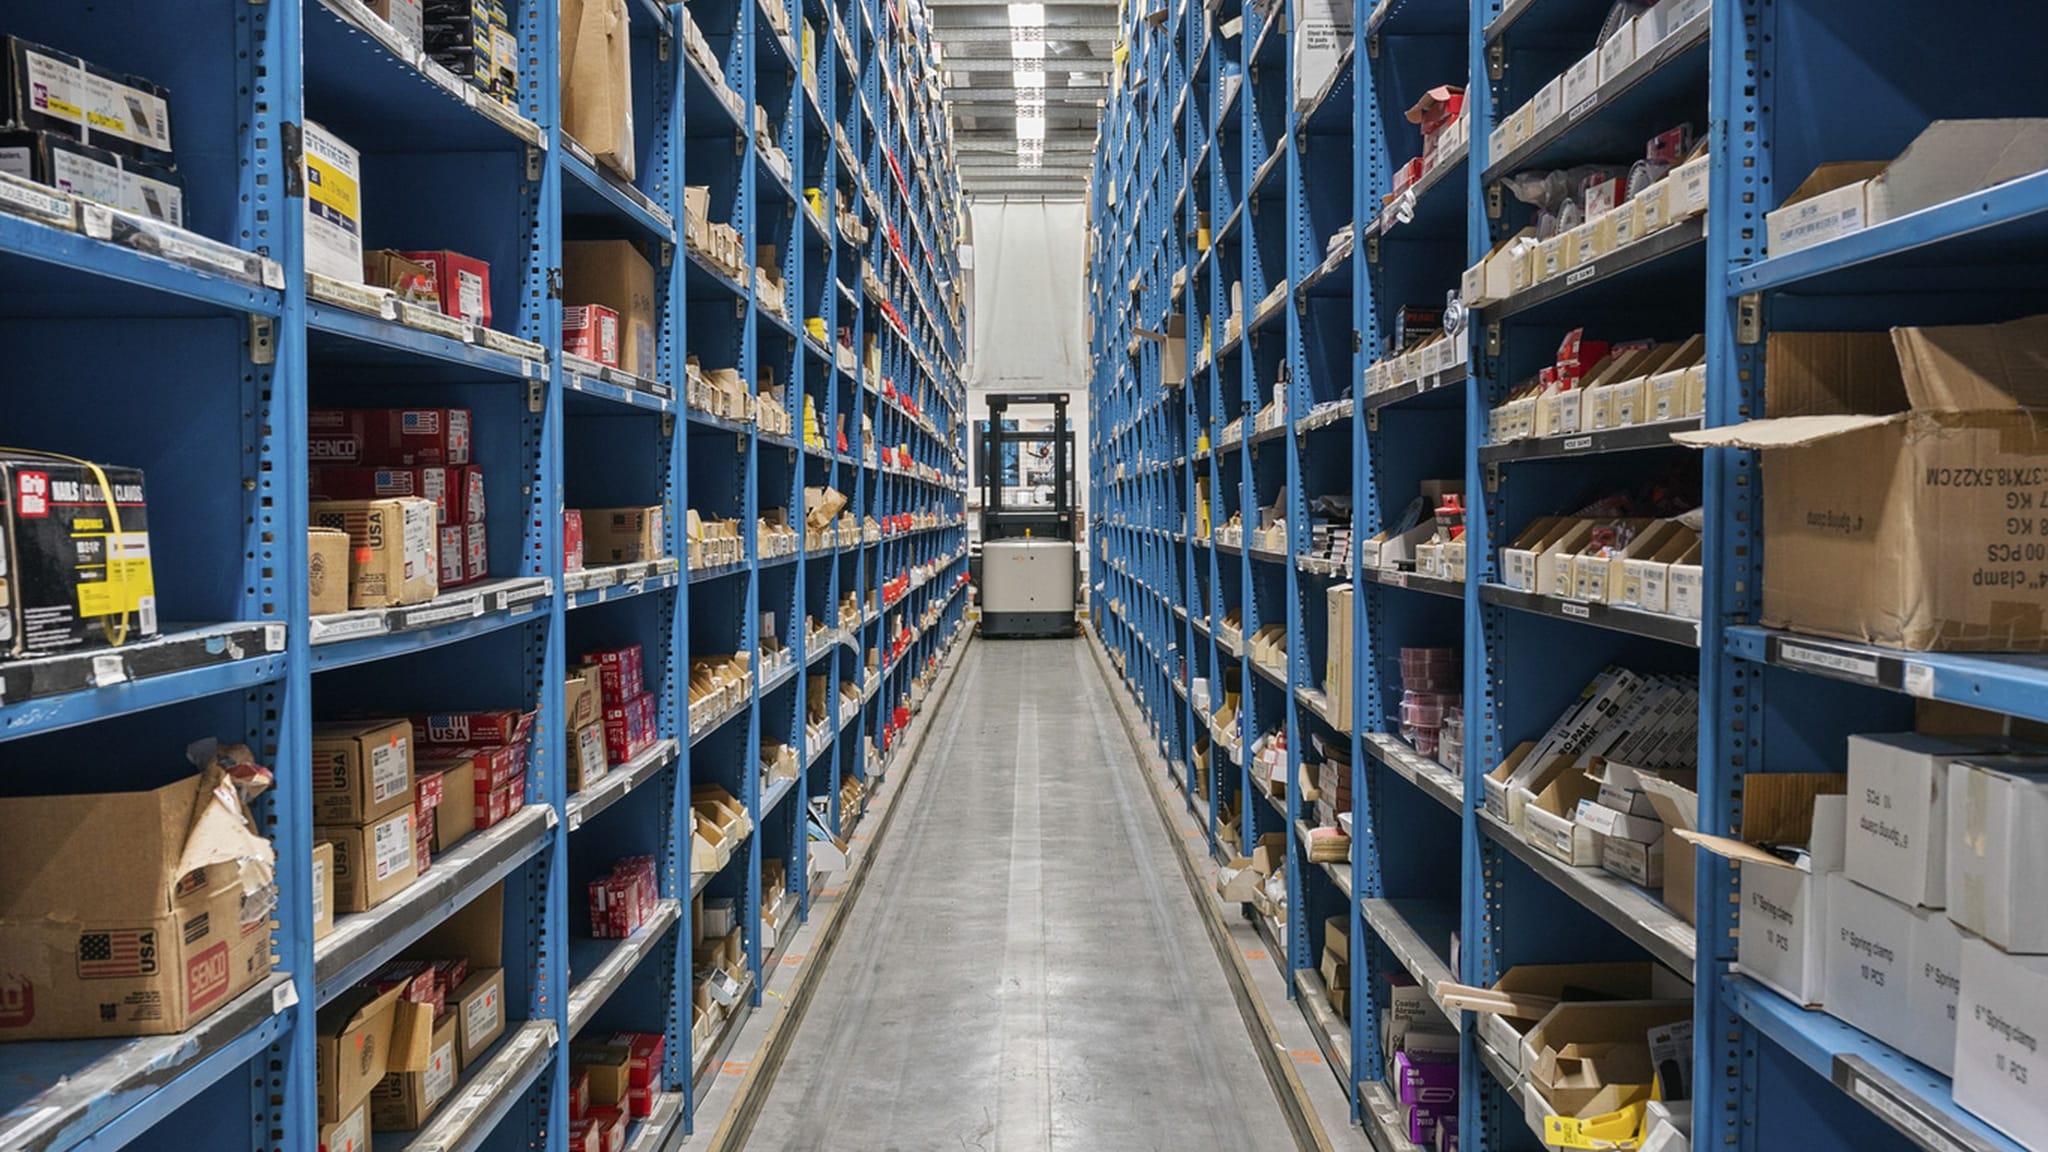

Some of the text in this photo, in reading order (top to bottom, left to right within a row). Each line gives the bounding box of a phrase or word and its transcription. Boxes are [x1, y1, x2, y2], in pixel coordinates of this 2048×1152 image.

[21, 474, 46, 496] Grip
[52, 481, 79, 502] NAILS
[2007, 491, 2032, 509] KG
[368, 512, 383, 548] USA
[2007, 518, 2033, 535] KG
[1988, 543, 2022, 562] PCS
[1973, 568, 2026, 590] clamp
[432, 728, 468, 741] USA
[333, 754, 347, 789] USA
[333, 841, 347, 876] USA
[1760, 897, 1777, 919] Spring
[139, 932, 155, 972] USA
[1776, 933, 1788, 951] PCS
[1850, 931, 1872, 957] Spring
[1873, 943, 1894, 963] clamp
[191, 953, 226, 992] SENCO
[1861, 964, 1884, 987] 10 PCS
[1936, 967, 1960, 996] Spring
[1986, 1008, 2011, 1042] Spring
[2012, 1025, 2037, 1054] clamp
[2010, 1061, 2027, 1084] PCS
